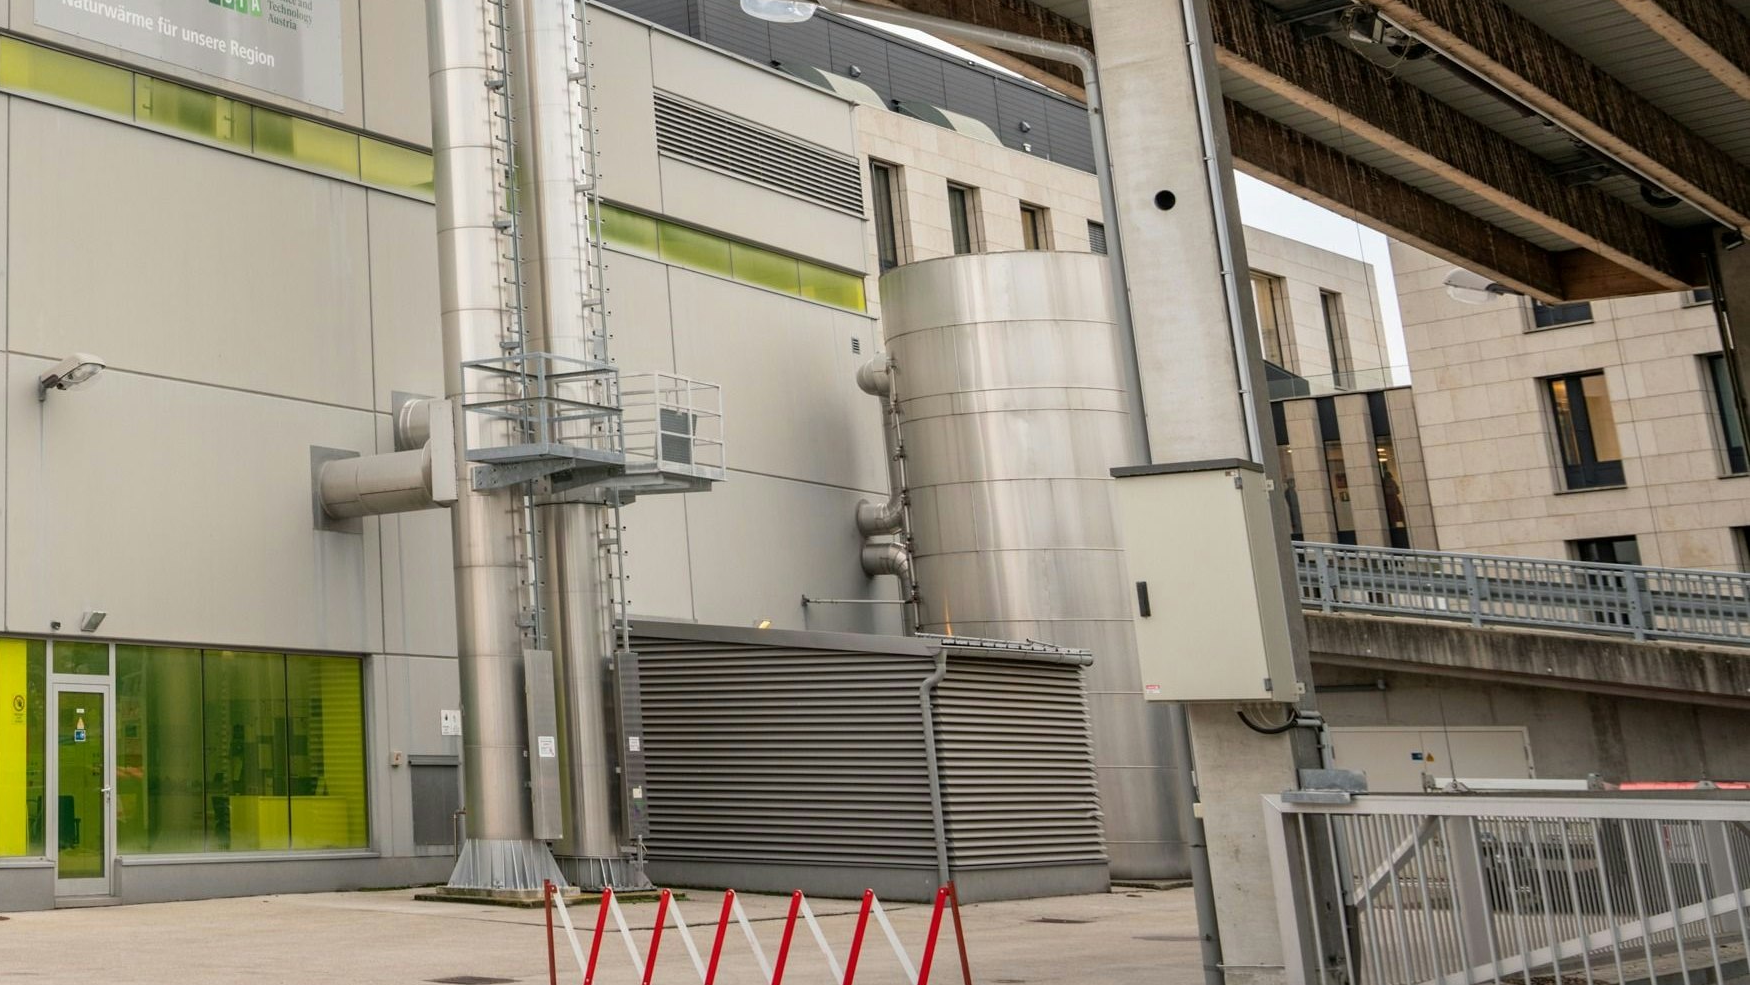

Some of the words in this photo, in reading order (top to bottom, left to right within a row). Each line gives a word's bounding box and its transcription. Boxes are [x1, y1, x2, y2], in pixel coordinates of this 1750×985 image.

[267, 0, 313, 25] Technology
[298, 0, 313, 11] and
[268, 14, 297, 30] Austria
[157, 16, 179, 37] für
[182, 26, 227, 53] unsere
[230, 39, 275, 67] Region
